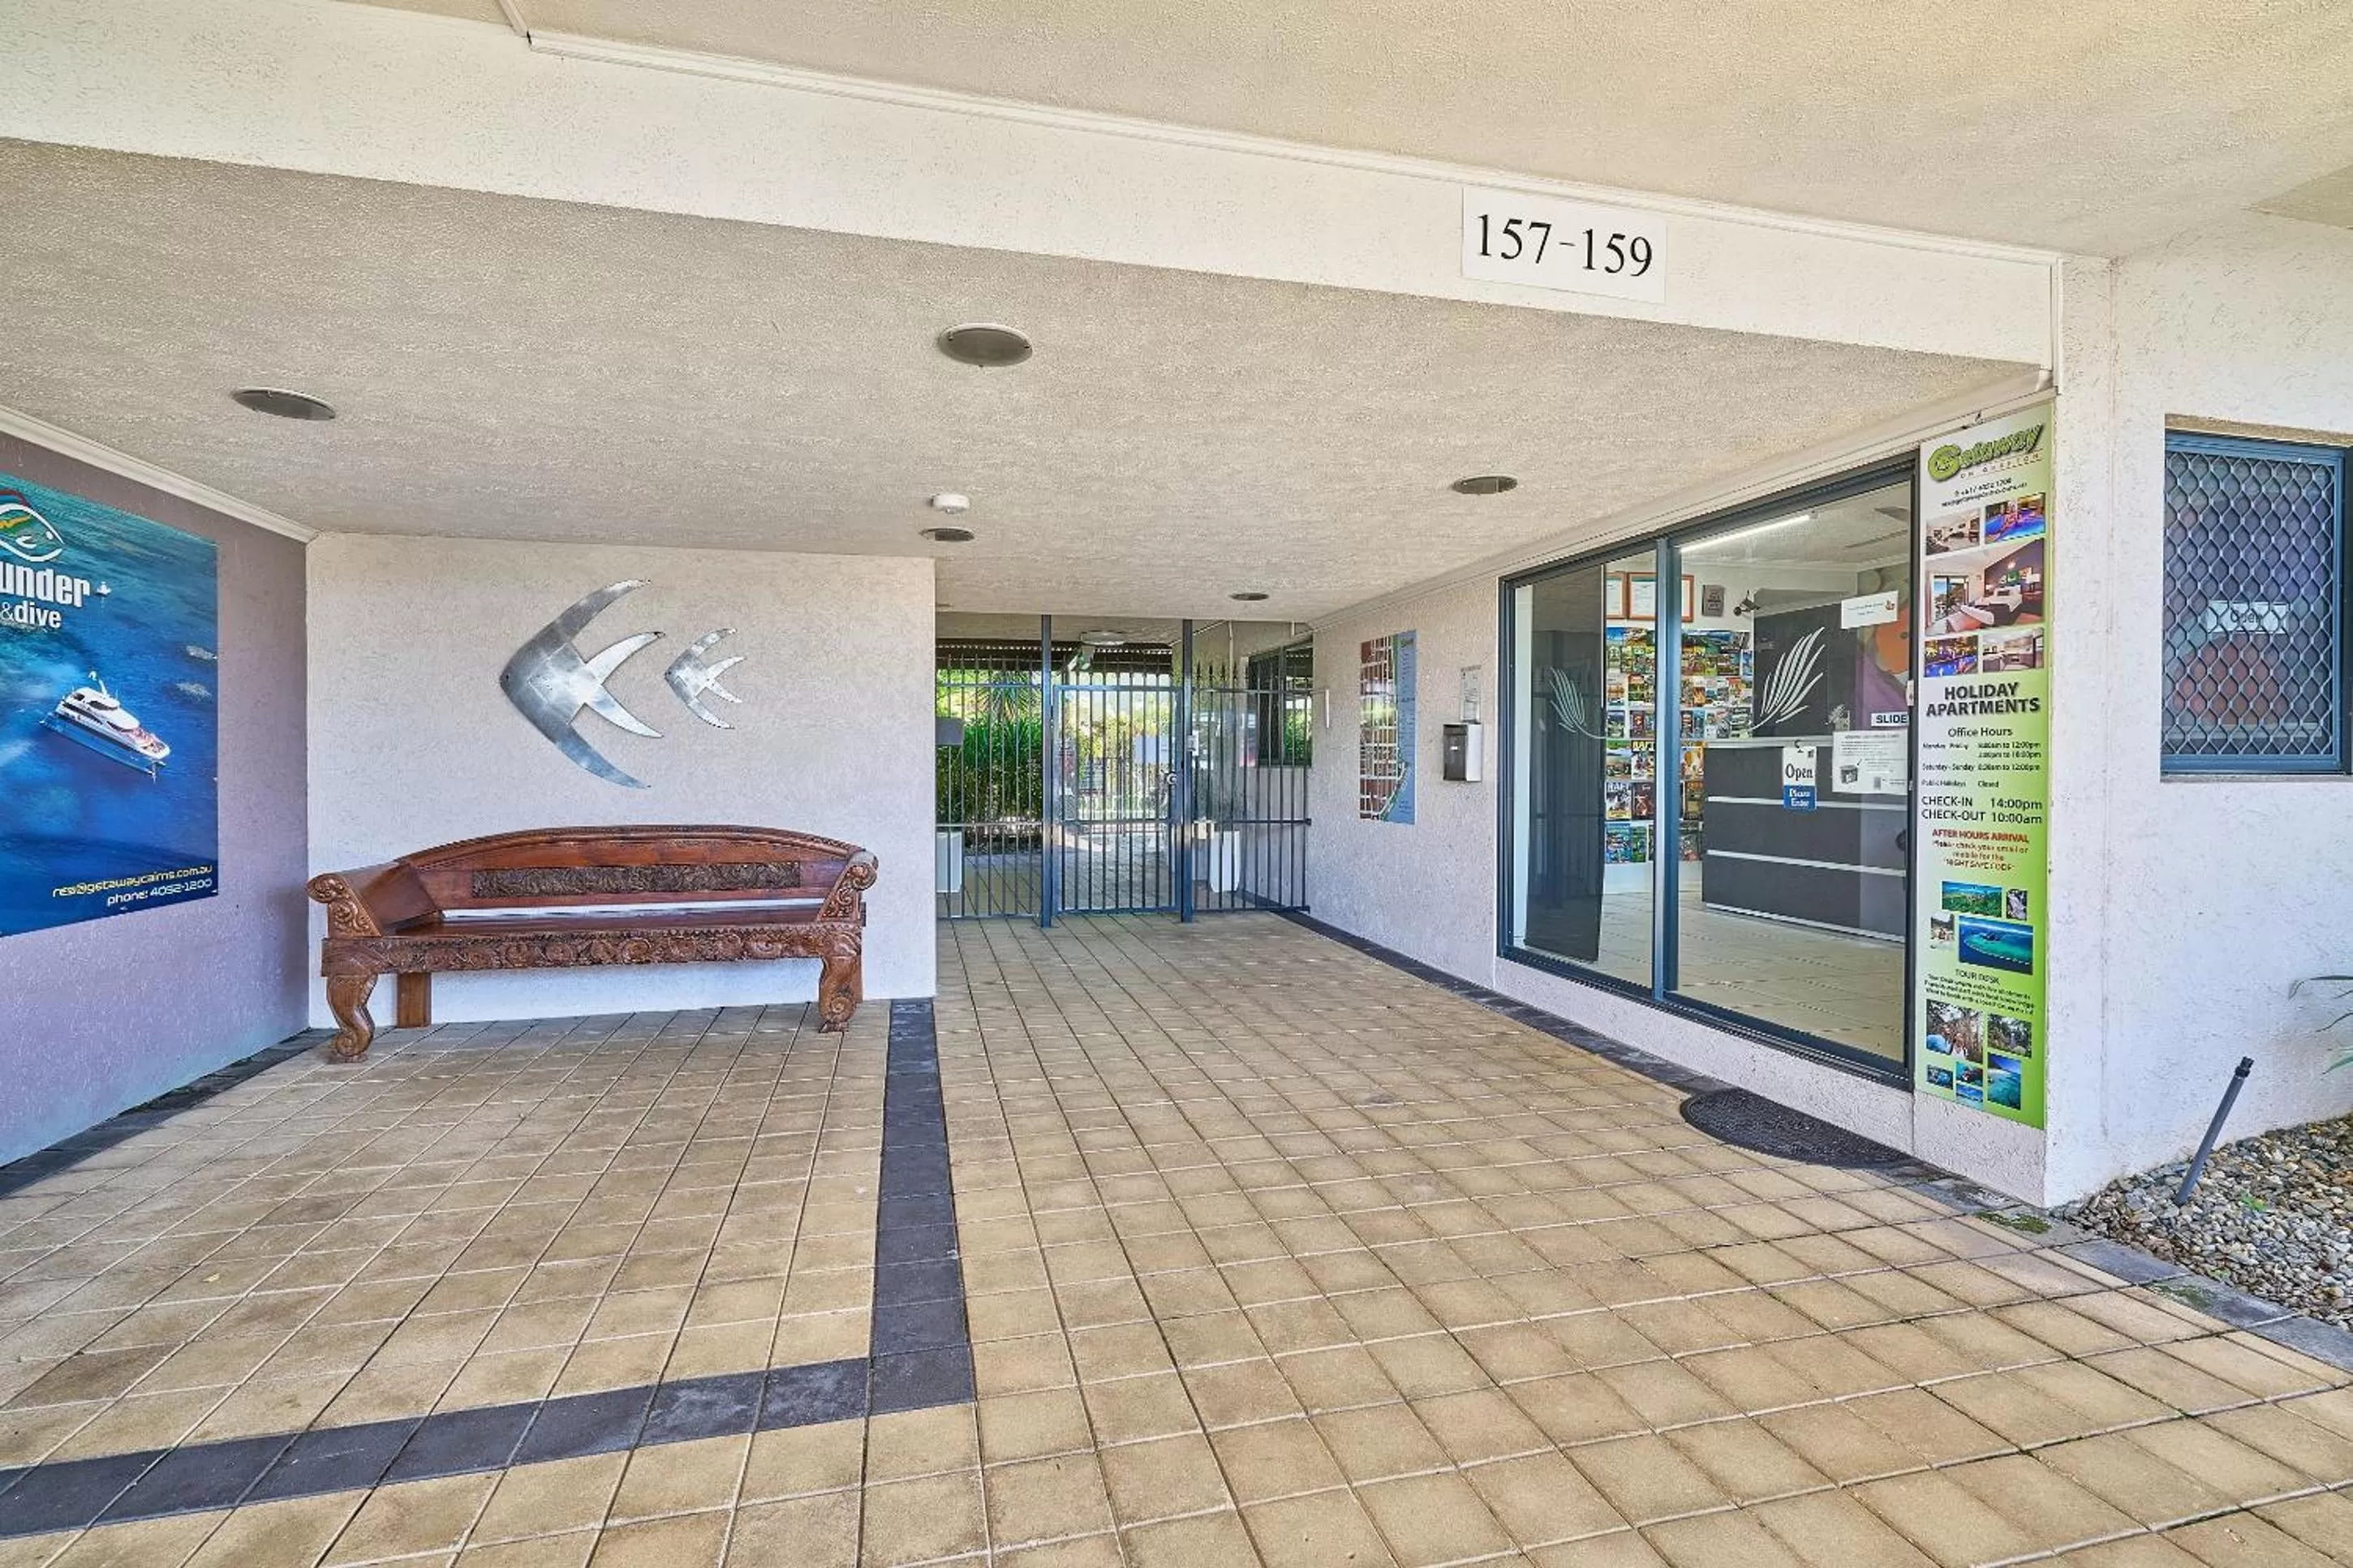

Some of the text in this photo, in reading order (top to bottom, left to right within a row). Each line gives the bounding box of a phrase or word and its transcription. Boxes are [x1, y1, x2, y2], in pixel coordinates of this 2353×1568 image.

[1478, 214, 1652, 277] 157-159
[1928, 423, 2044, 482] Getaway
[1944, 682, 2019, 700] HOLIDAY
[1925, 698, 2041, 717] APARTMENTS
[1875, 715, 1908, 724] SLIDE
[1947, 728, 2013, 737] Office Hours
[1785, 763, 1813, 781] Open
[1921, 796, 2043, 810] CHECK-IN 14:00pm
[1921, 809, 2042, 823] CHECK-OUT 10:00am
[1932, 829, 2028, 843] AFTER HOURS ARRIVAL
[53, 864, 213, 898] res@getawaycairns.com.au
[107, 879, 213, 907] phone: 4052-1200
[1955, 969, 1977, 980] TOUR
